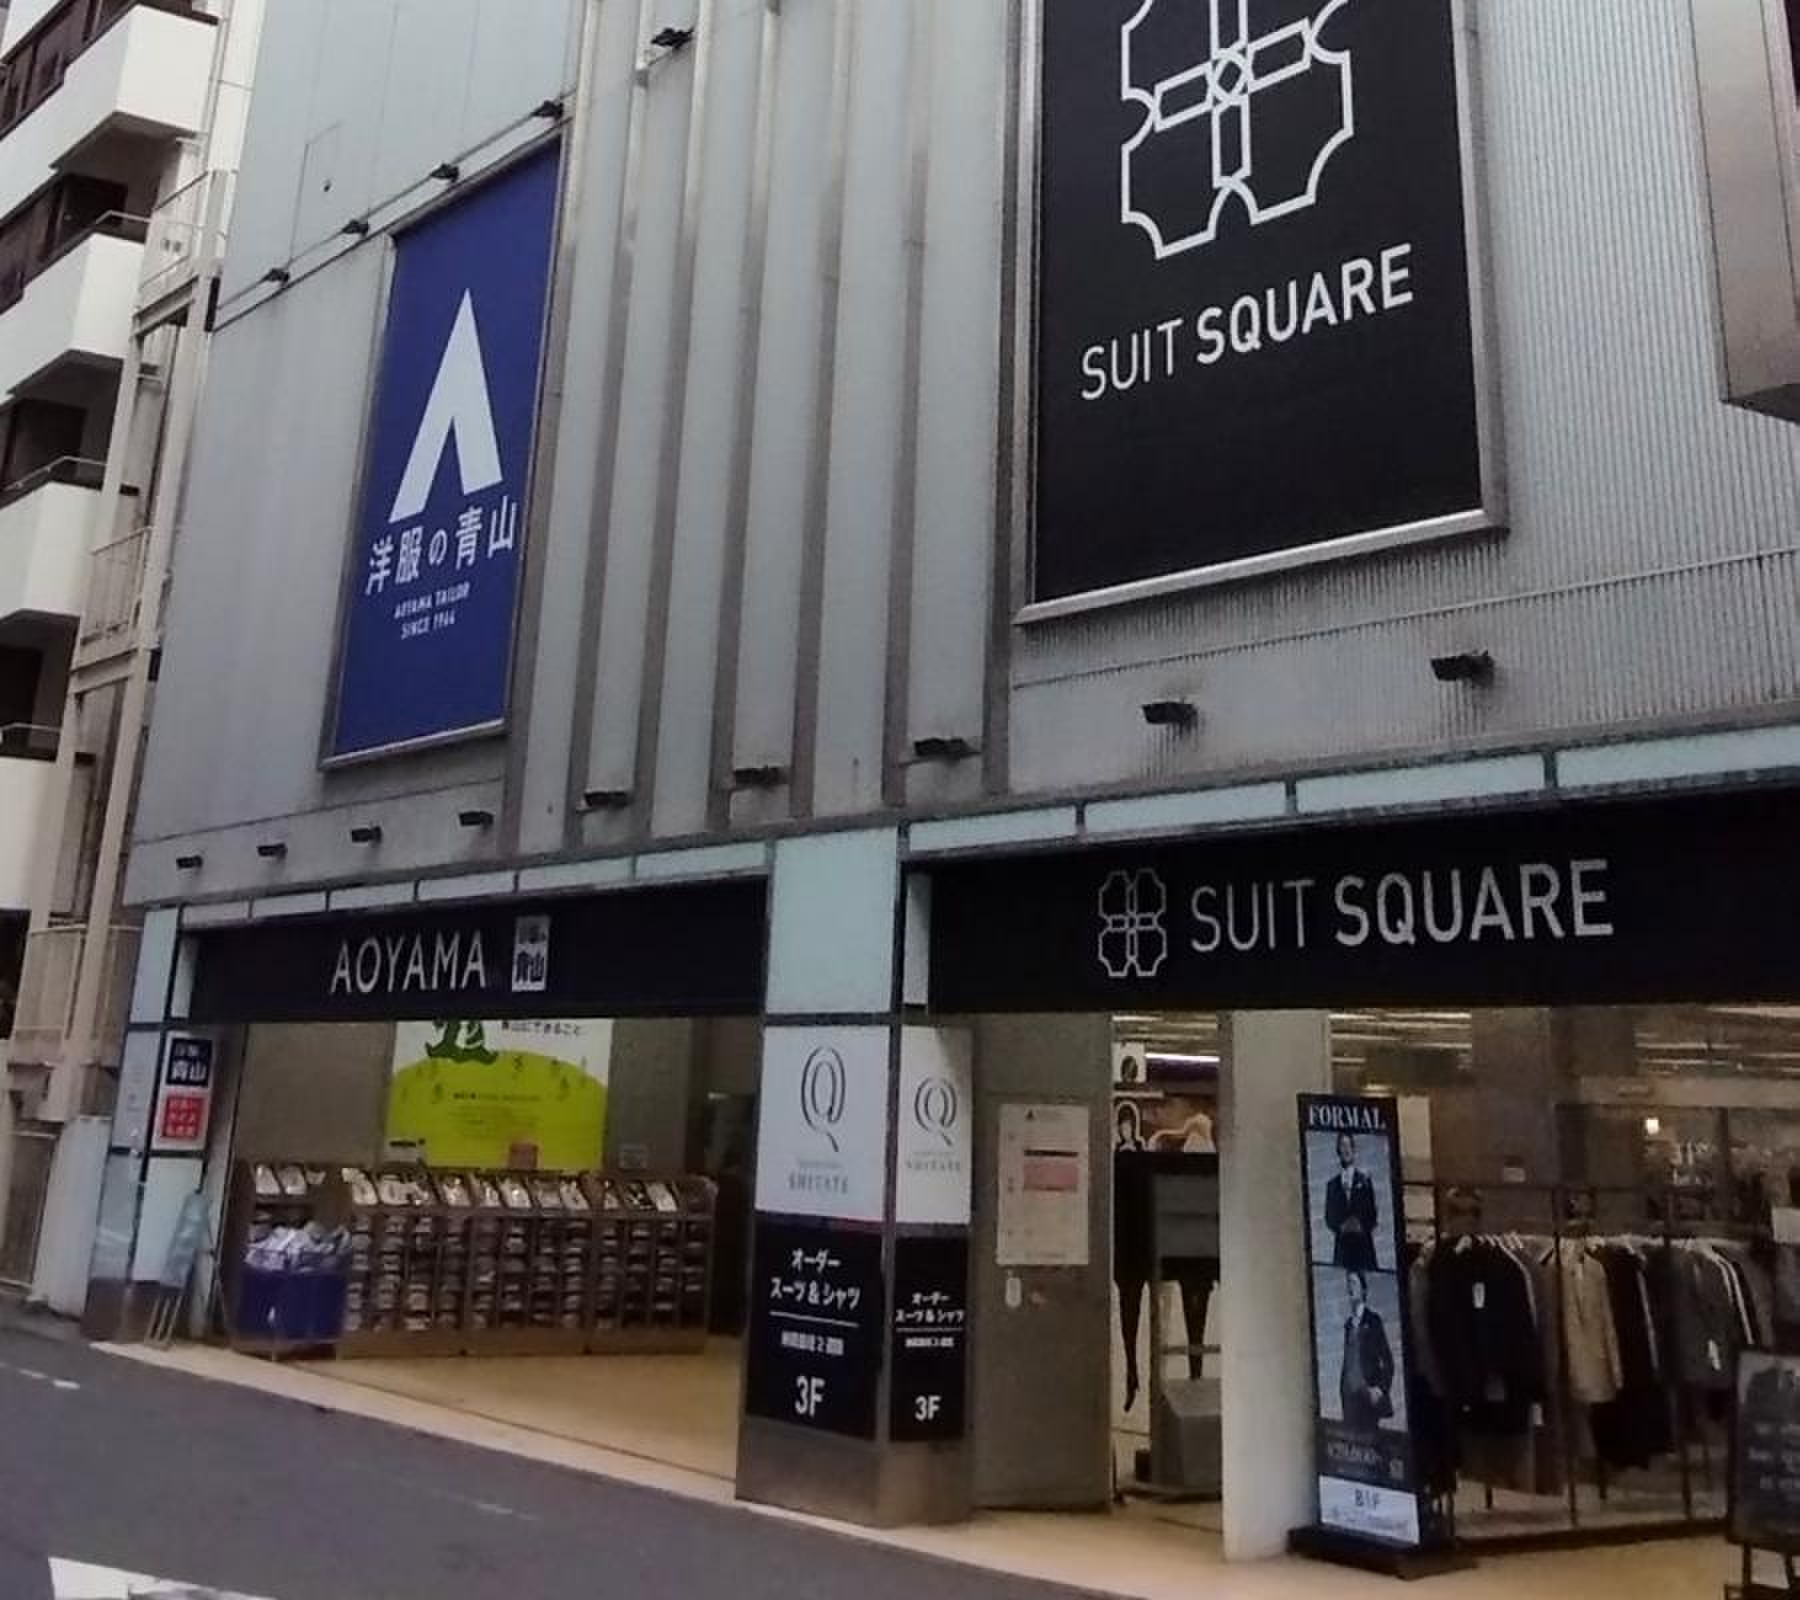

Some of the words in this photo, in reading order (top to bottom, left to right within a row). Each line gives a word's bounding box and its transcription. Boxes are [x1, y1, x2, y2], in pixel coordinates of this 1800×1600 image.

[1081, 319, 1184, 401] SUIT
[1196, 243, 1414, 365] SQUARE
[365, 495, 517, 596] 洋服の青山
[1191, 880, 1315, 953] SUIT
[1334, 859, 1614, 946] SQUARE
[330, 930, 487, 994] AOYAMA
[1308, 1104, 1387, 1130] FORMAL
[795, 1376, 825, 1417] 3F
[915, 1395, 942, 1420] 3F
